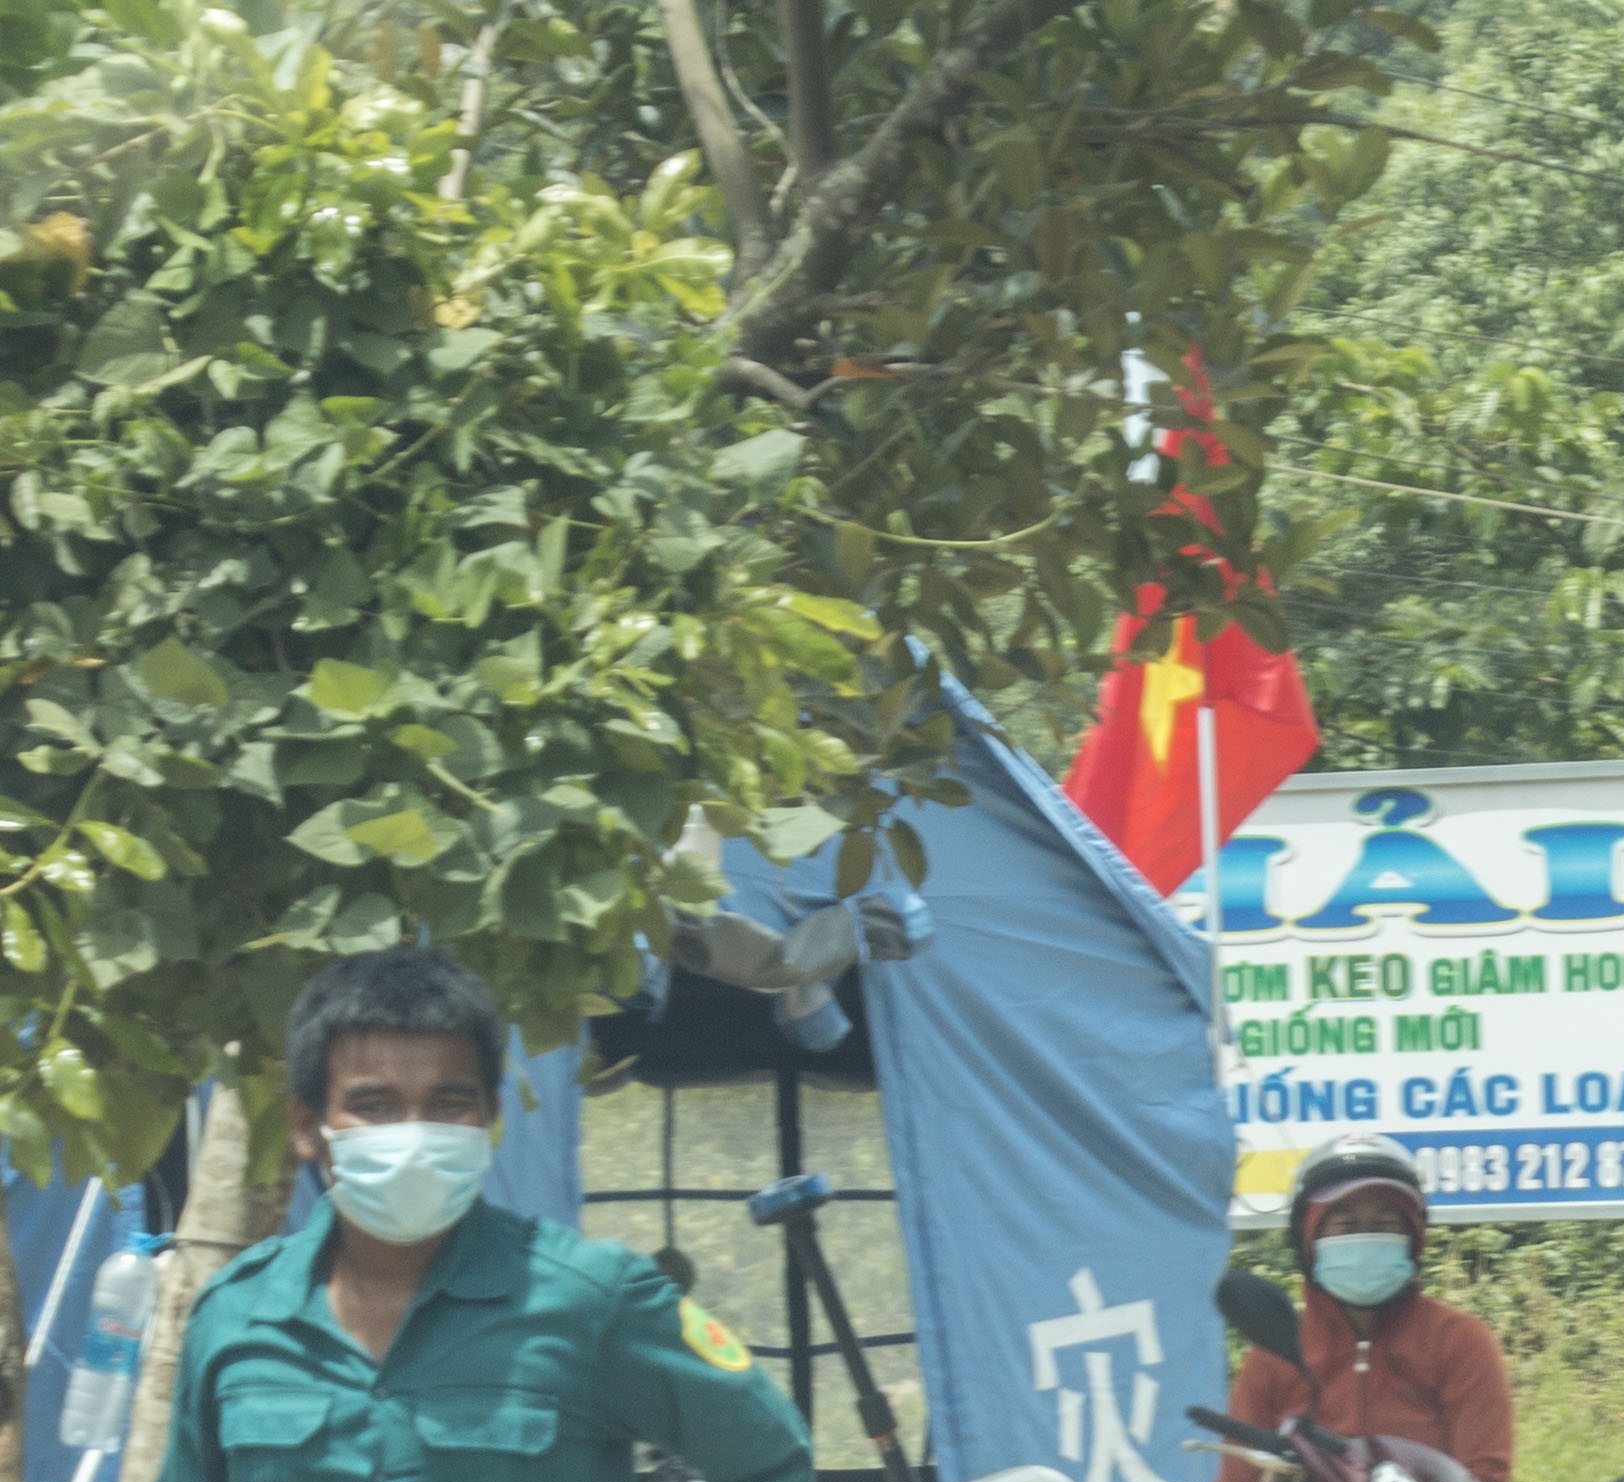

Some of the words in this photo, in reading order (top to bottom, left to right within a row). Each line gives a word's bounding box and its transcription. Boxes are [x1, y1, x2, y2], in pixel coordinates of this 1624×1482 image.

[1306, 952, 1412, 1000] KEO
[1239, 1002, 1380, 1058] GIỐNG
[1393, 1005, 1482, 1054] MỚI
[1228, 1065, 1379, 1124] IỐNG
[1400, 1067, 1521, 1120] CÁC
[1415, 1144, 1510, 1195] 0983
[1515, 1142, 1591, 1191] 212
